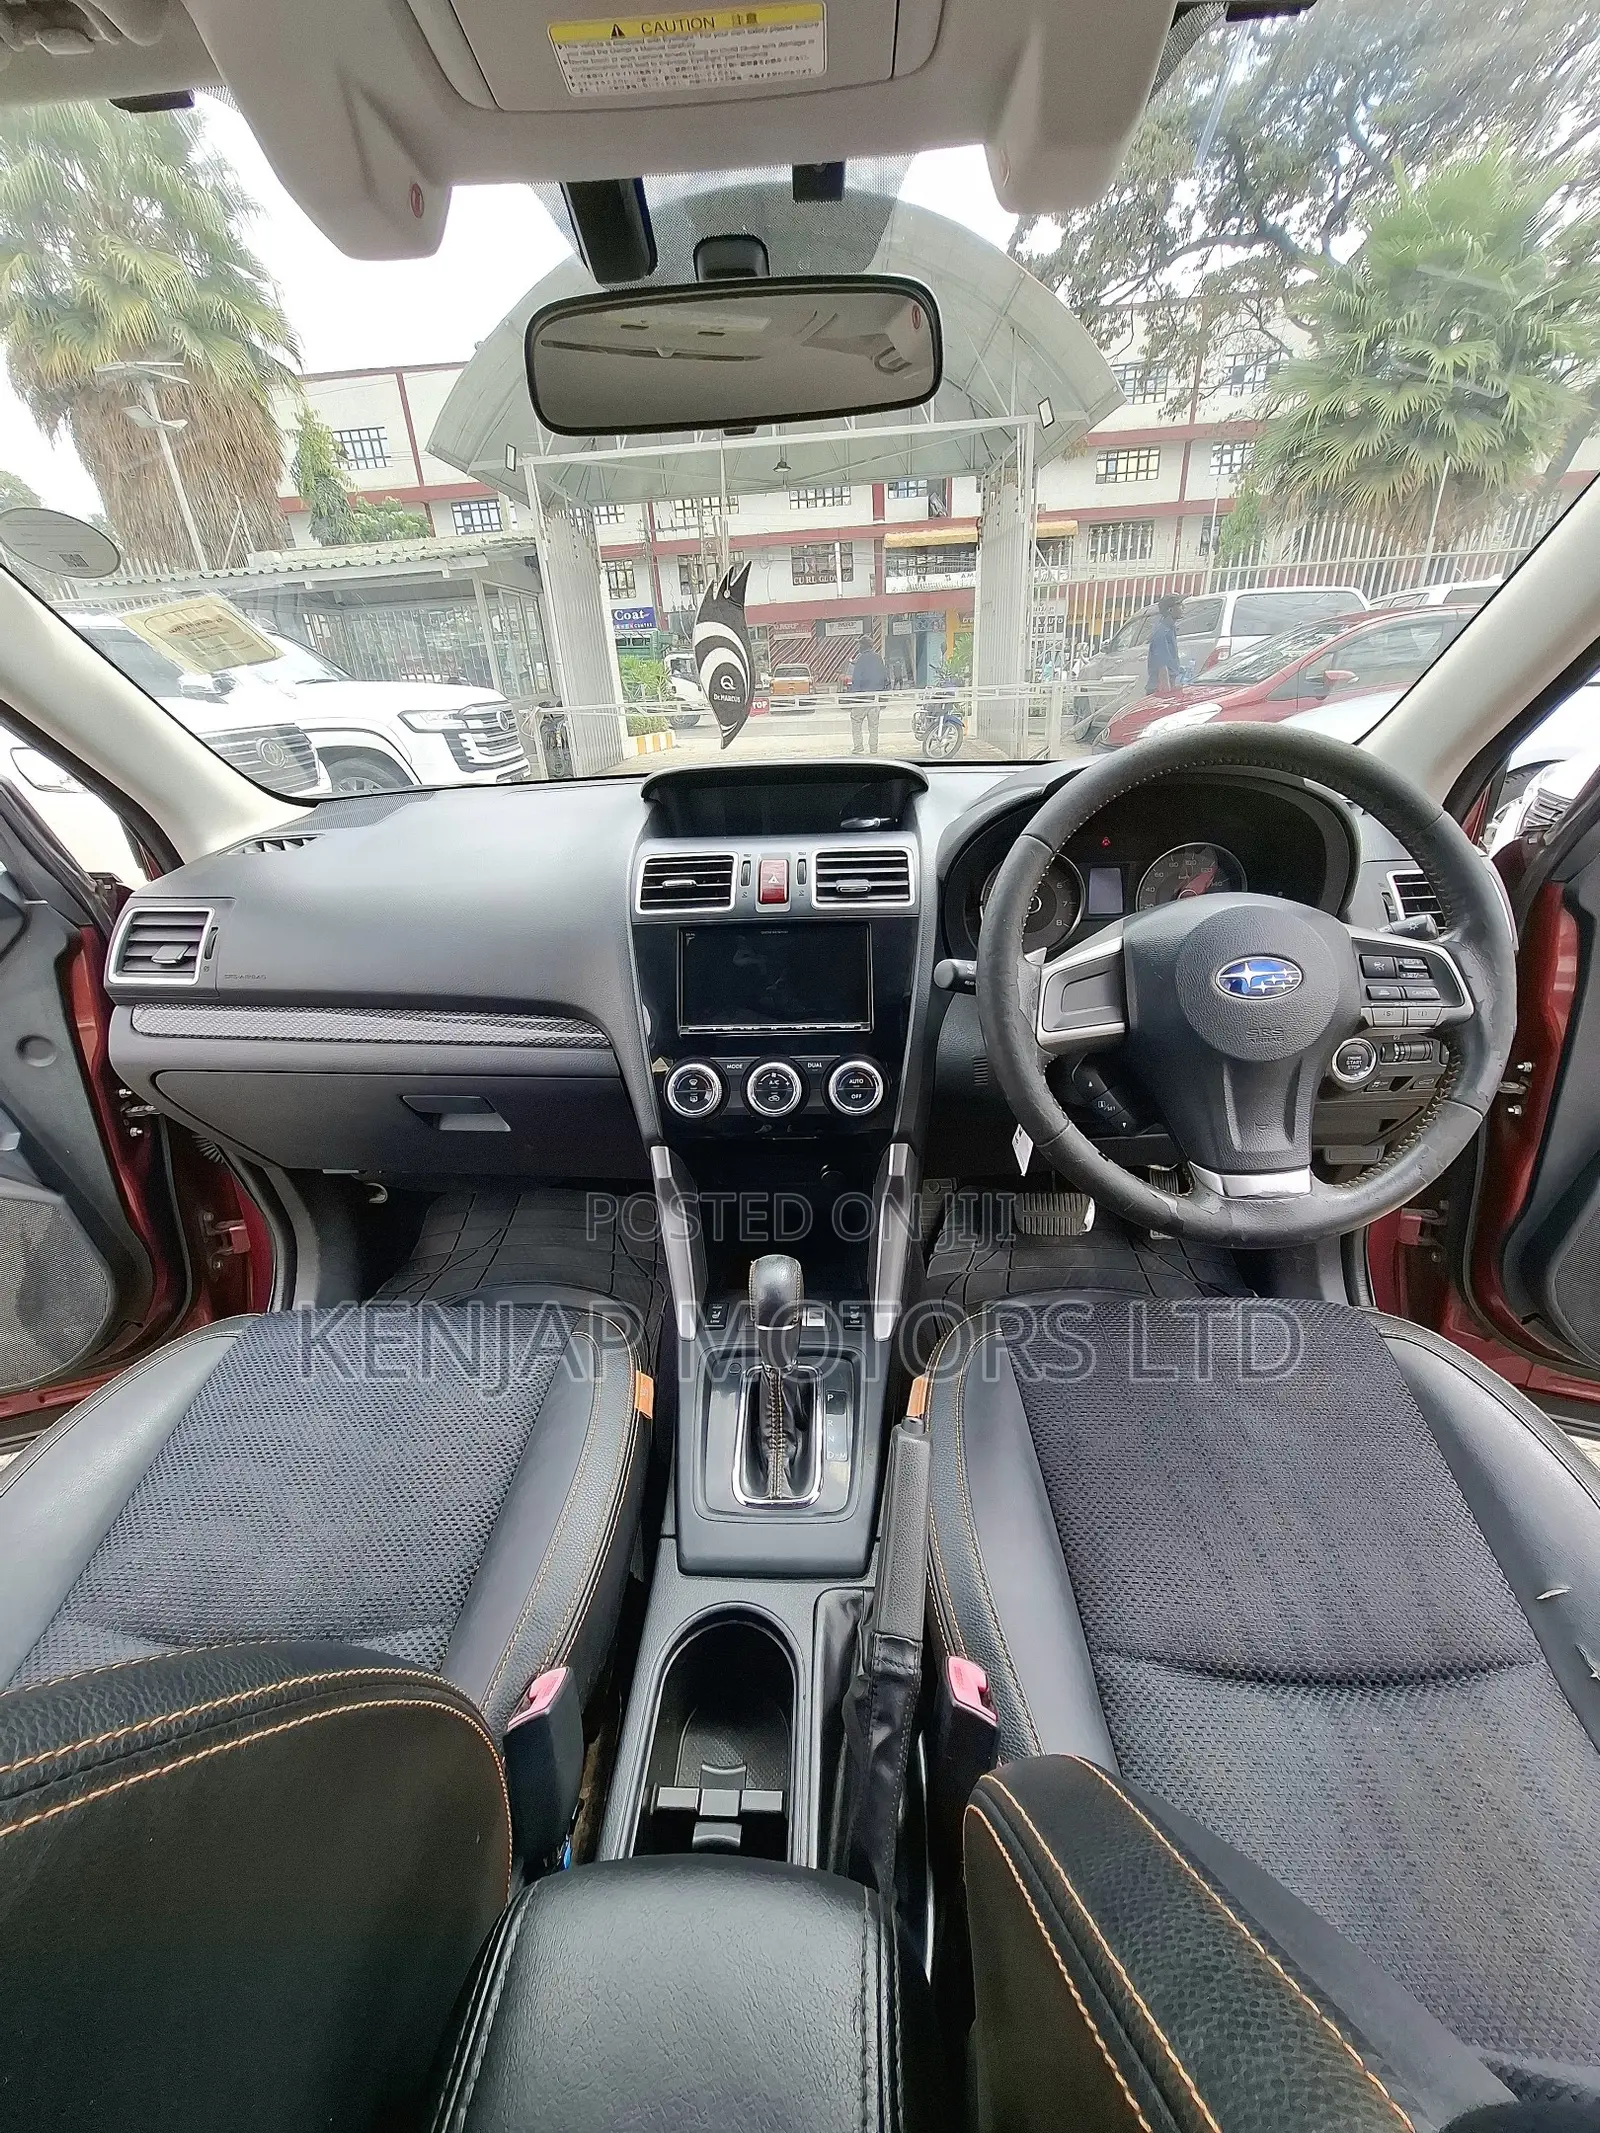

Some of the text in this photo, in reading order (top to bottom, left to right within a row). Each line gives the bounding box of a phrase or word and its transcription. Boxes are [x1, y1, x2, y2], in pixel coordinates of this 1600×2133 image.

[641, 17, 716, 36] CAUTION
[614, 610, 645, 621] Coat
[752, 701, 768, 709] TOP
